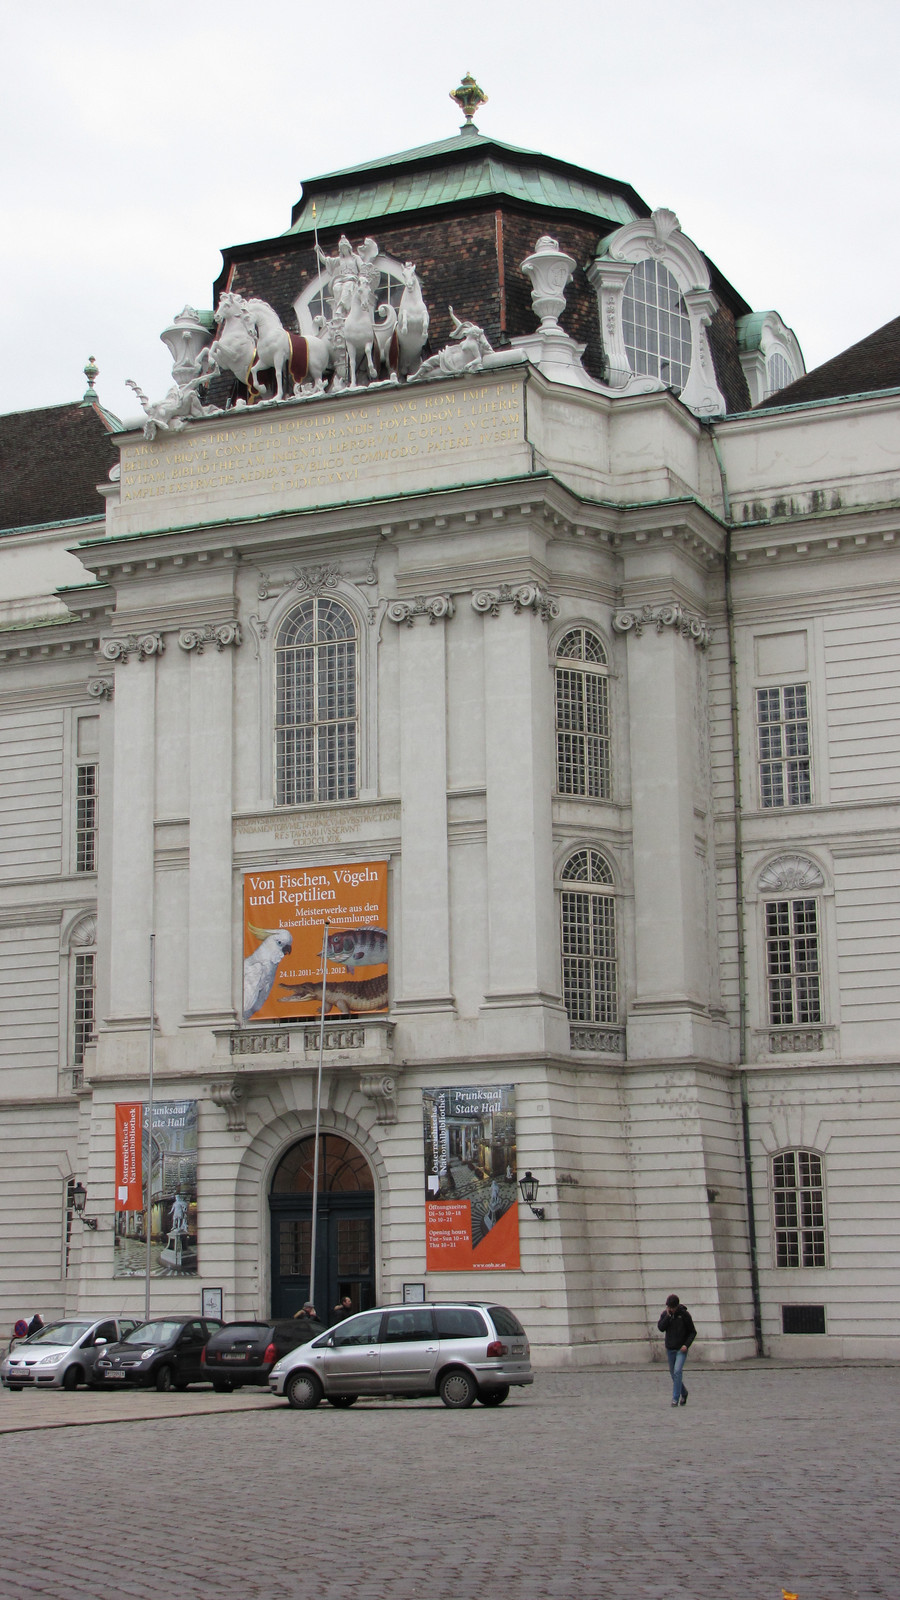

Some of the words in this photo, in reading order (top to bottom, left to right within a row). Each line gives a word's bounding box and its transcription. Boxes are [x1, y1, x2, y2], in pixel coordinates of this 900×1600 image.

[123, 458, 159, 473] BELLO
[166, 450, 208, 465] VBIQVE
[215, 440, 281, 458] CONFECTO
[288, 424, 373, 446] INSTAVRANDIS
[380, 407, 464, 431] FOVENDISQVE
[472, 399, 519, 416] LITERIS
[188, 430, 247, 447] AVSTRIVS
[270, 415, 335, 434] LEOPOLDI
[172, 455, 265, 480] BIBLIOTHECAM
[273, 447, 322, 463] INGENTI
[408, 425, 454, 441] COPIA
[463, 413, 520, 432] AVCTAM
[293, 457, 344, 474] PVBLICO
[427, 436, 472, 453] PATERE
[480, 428, 520, 444] IVSSIT
[249, 877, 275, 891] Von
[279, 872, 331, 889] Fischen,
[333, 867, 378, 887] Vögeln
[249, 890, 275, 906] und
[278, 886, 336, 906] Reptilien
[295, 905, 347, 917] Meisterwerke
[349, 904, 362, 913] aus
[364, 902, 379, 912] den
[279, 917, 325, 928] kaiserlichen
[327, 914, 379, 925] Sammlungen
[455, 1089, 502, 1100] Prunksaal
[144, 1105, 187, 1116] Punksaal
[455, 1104, 479, 1114] State
[481, 1102, 501, 1113] Hall
[144, 1119, 166, 1129] Sate
[167, 1117, 185, 1127] Hall
[438, 1092, 447, 1173] Nationalbibliothek
[431, 1105, 439, 1173] Österreichische
